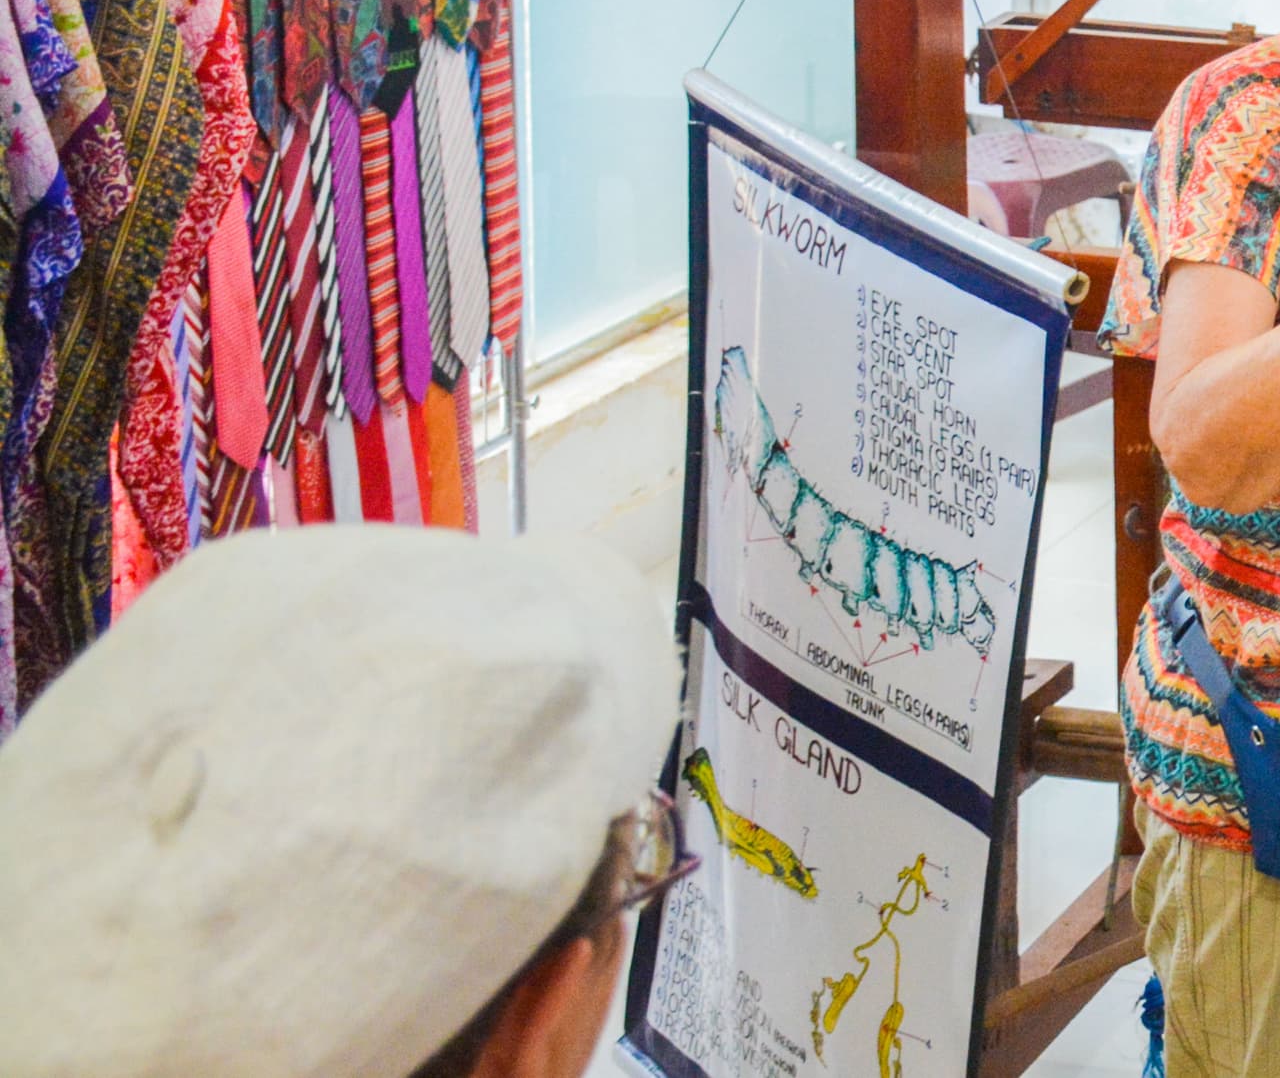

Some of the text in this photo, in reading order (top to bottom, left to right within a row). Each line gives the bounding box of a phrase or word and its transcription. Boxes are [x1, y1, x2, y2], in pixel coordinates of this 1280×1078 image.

[733, 177, 847, 275] SILKWORM
[871, 289, 902, 326] EYE
[916, 315, 959, 355] SPOT
[871, 314, 955, 376] CRESCENT
[870, 339, 908, 382] STAR
[916, 365, 955, 403] SPOT
[870, 364, 925, 415] CAUDAL
[933, 399, 977, 439] HORN
[870, 388, 921, 437] CAUDAL
[928, 421, 975, 463] LEGS
[870, 413, 924, 462] STIGMA
[867, 461, 918, 508] MOUTH
[928, 493, 976, 538] PARTS
[870, 436, 942, 495] THORACIC
[953, 482, 996, 527] LEGS
[805, 642, 877, 695] ABDOMINAL
[886, 684, 921, 719] LEGS
[845, 688, 886, 723] TRUNK
[721, 671, 862, 795] SILK GLAND
